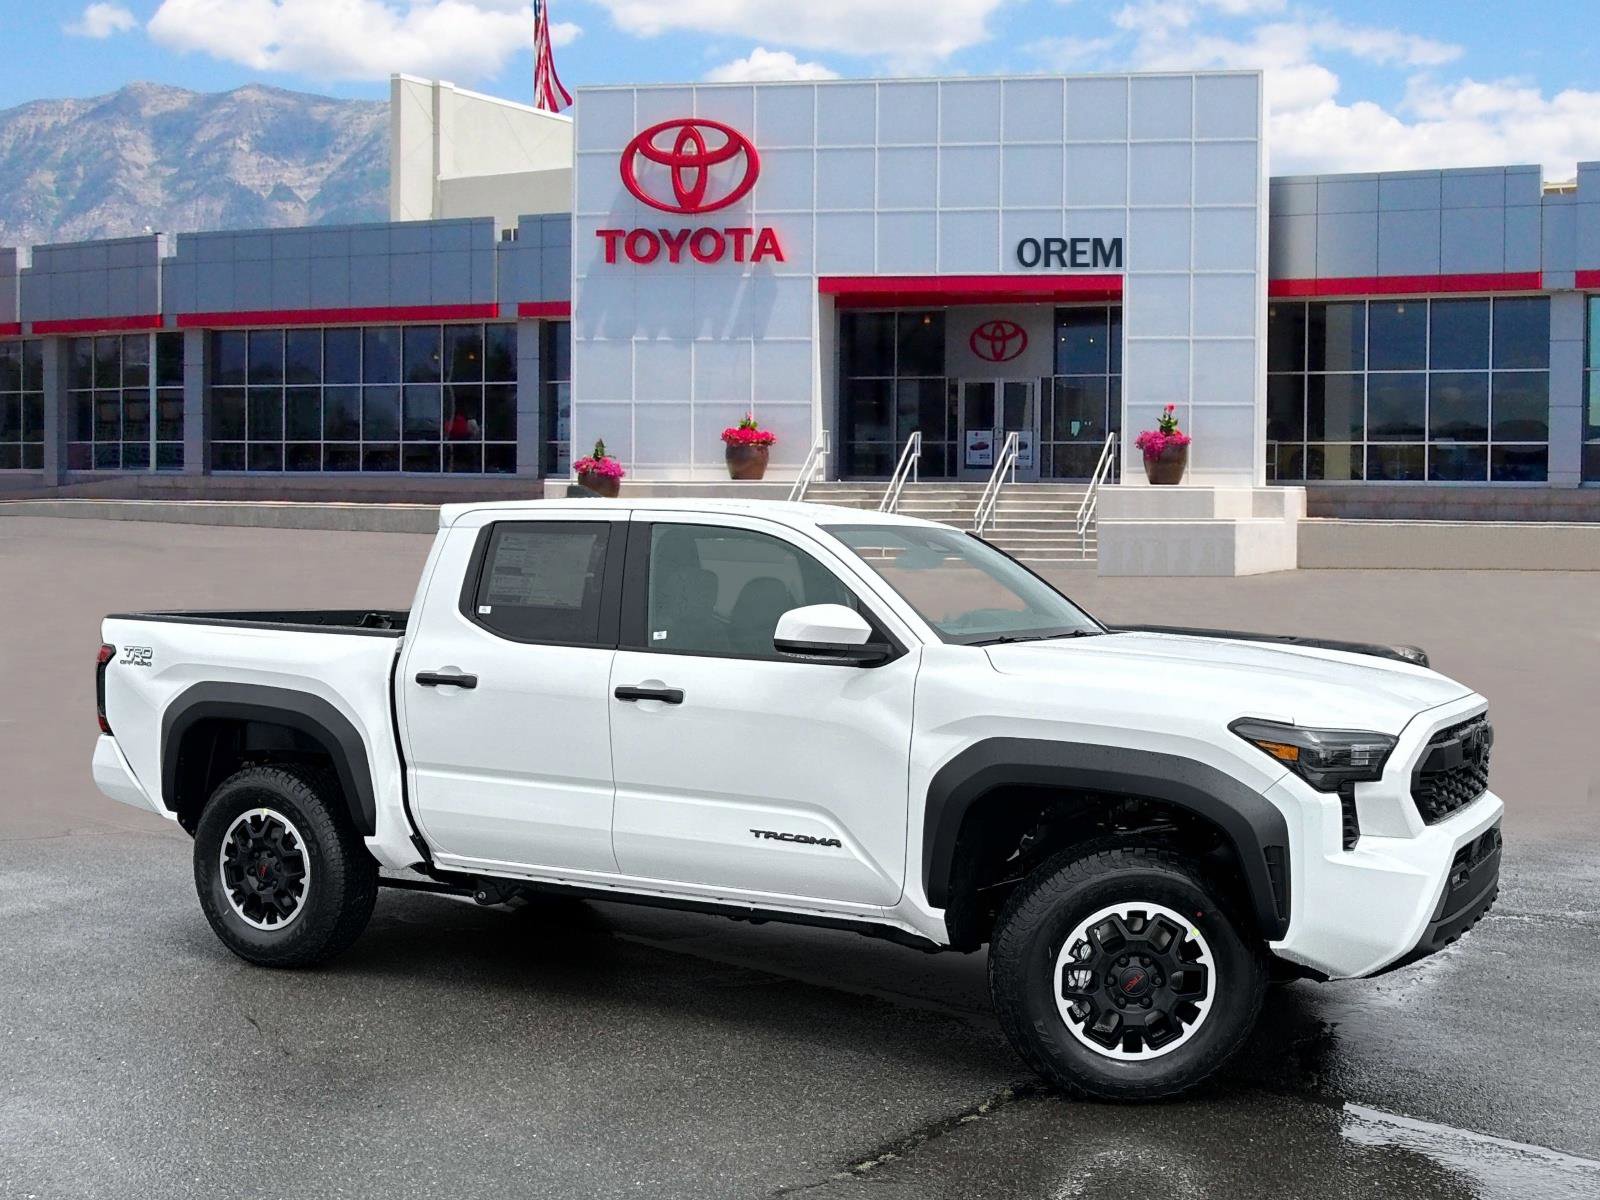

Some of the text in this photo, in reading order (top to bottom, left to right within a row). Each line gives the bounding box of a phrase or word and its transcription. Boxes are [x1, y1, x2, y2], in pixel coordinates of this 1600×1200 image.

[596, 227, 785, 264] TOYOTA
[1017, 237, 1123, 268] OREM
[123, 646, 153, 660] TRD
[749, 829, 842, 848] TACOMA
